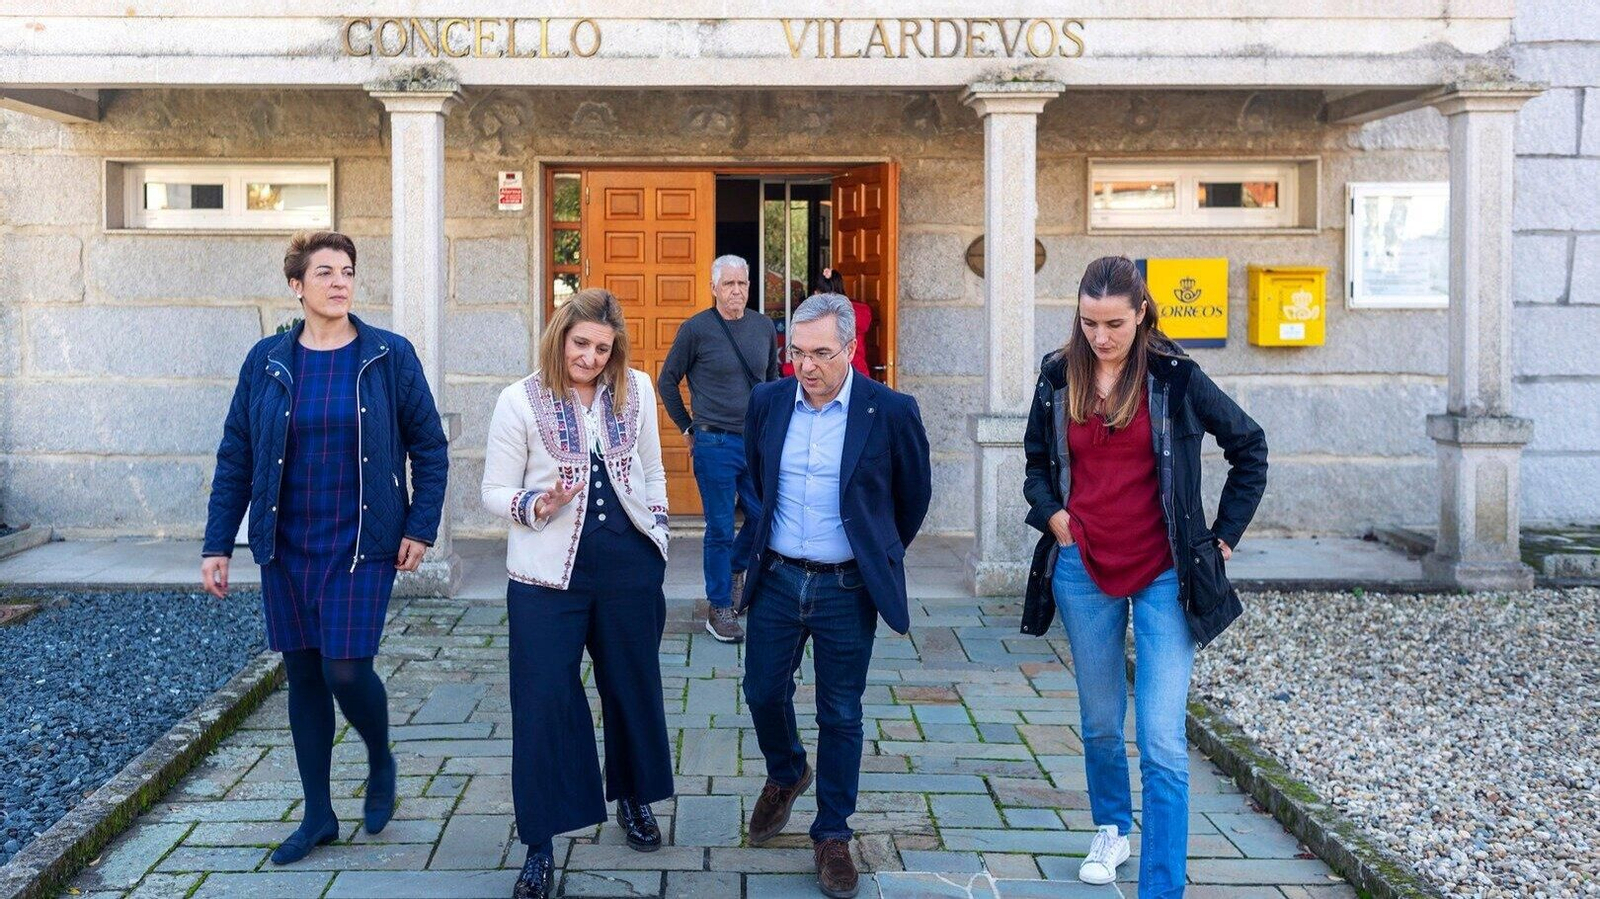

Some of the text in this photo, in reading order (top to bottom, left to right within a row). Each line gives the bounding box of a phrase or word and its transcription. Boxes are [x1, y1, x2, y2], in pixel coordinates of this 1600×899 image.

[343, 17, 1085, 59] CONCELLO VILARDEVOS
[1157, 304, 1223, 318] ORREOS
